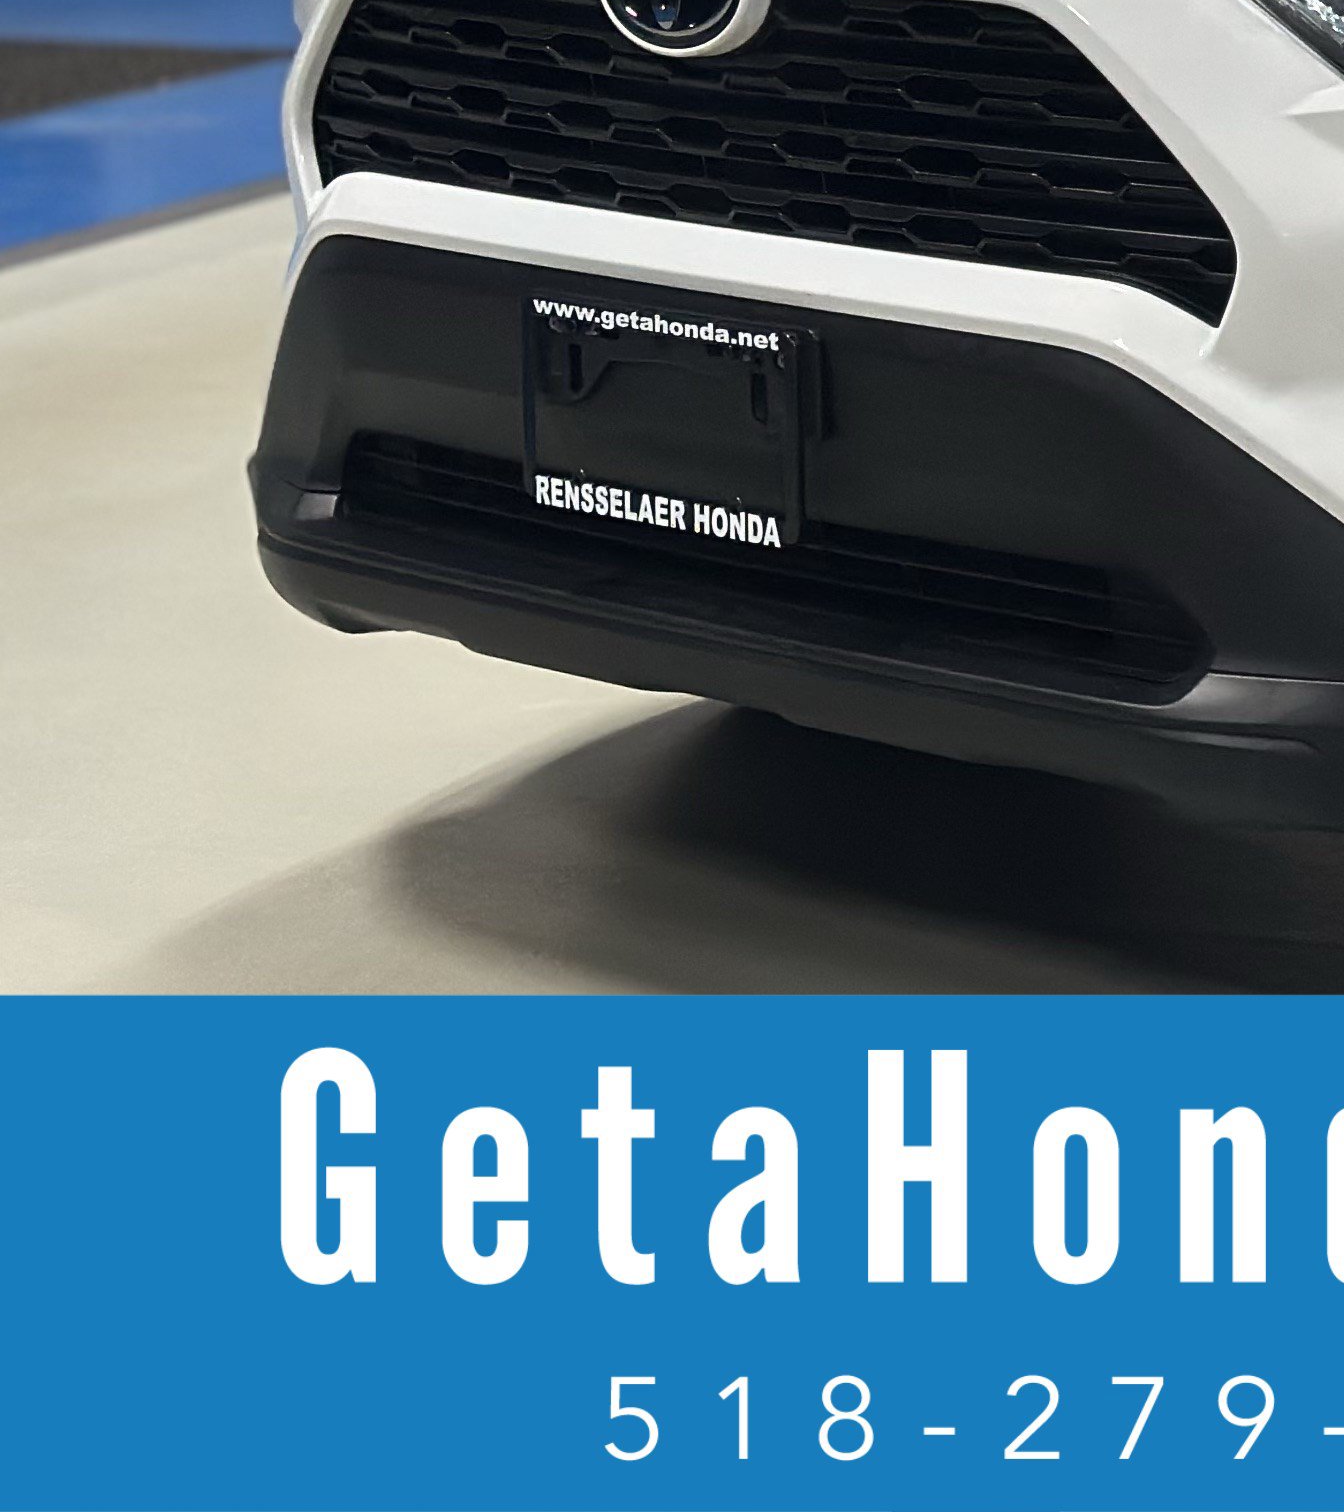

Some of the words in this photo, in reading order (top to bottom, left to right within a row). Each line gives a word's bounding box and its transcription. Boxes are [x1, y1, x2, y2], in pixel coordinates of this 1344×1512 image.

[533, 298, 779, 351] www.getahonda.net
[534, 474, 686, 531] RENSSELAER
[693, 502, 781, 548] HONDA
